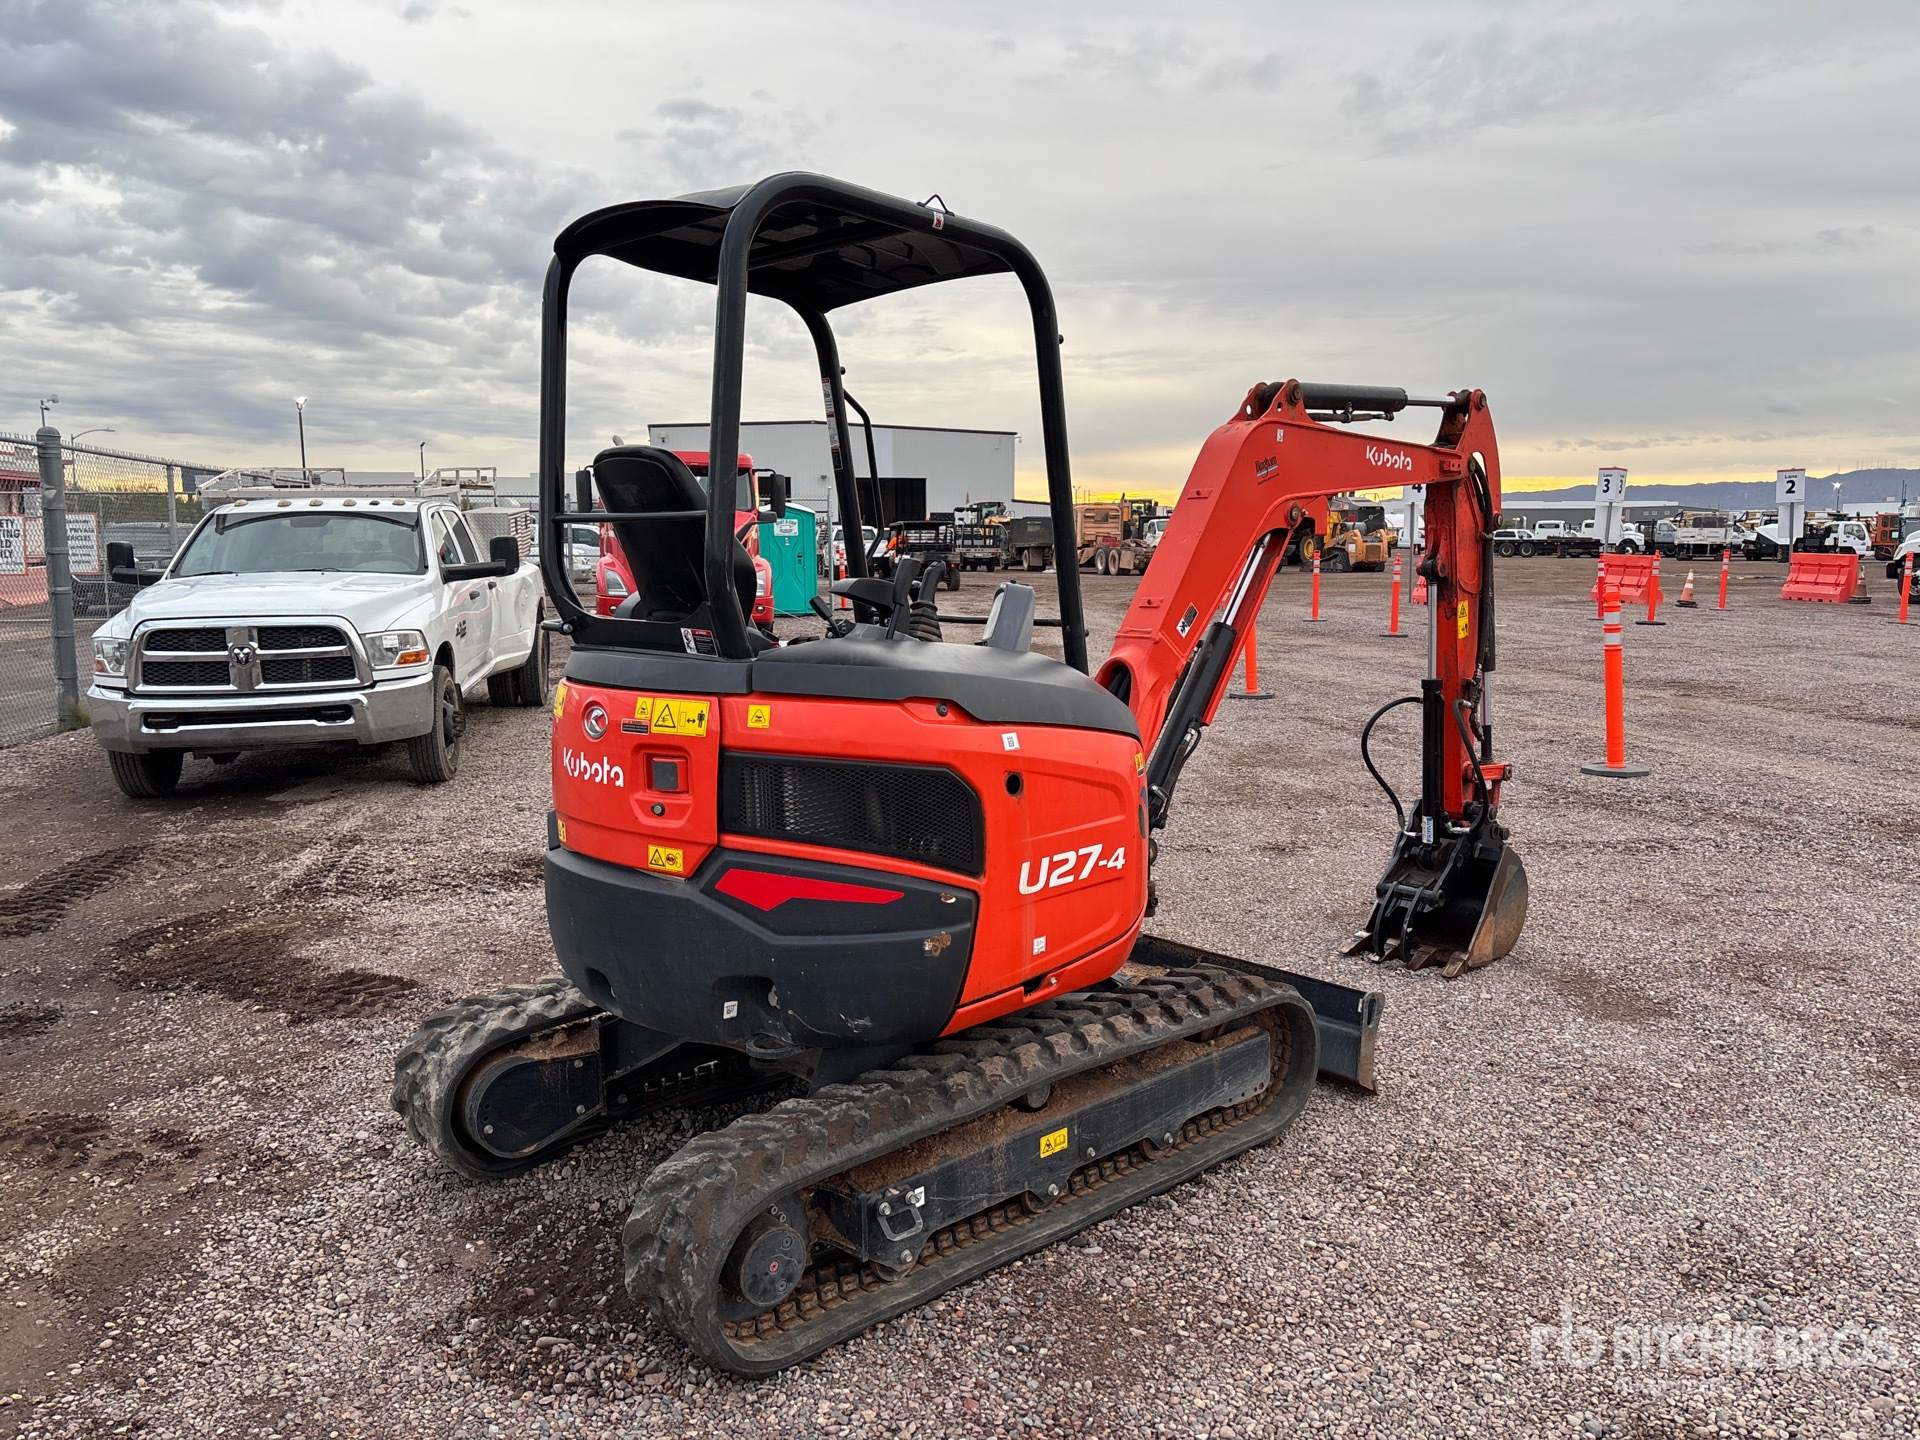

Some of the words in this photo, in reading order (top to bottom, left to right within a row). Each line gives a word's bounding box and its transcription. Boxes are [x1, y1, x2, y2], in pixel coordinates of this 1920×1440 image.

[1366, 445, 1412, 471] Kubota
[1411, 484, 1423, 493] 4
[1602, 478, 1611, 494] 3
[1785, 479, 1796, 494] 2
[563, 747, 624, 788] Kubota
[1018, 843, 1126, 895] U27-4
